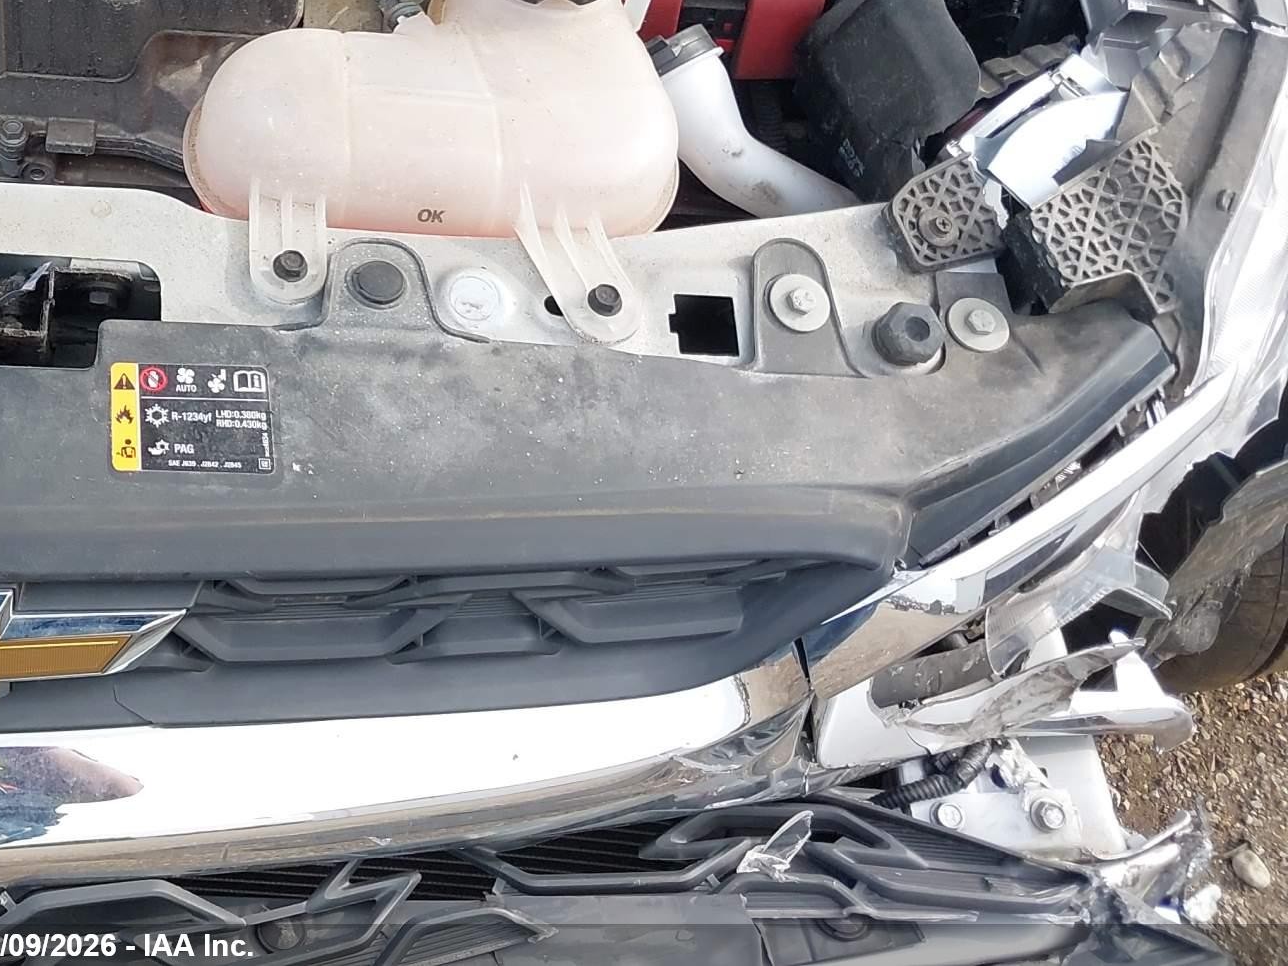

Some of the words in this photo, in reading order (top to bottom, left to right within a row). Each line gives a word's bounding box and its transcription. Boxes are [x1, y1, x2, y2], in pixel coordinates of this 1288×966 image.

[417, 208, 446, 223] OK
[175, 384, 197, 393] AUTO
[171, 411, 213, 424] R-1234yf
[173, 443, 195, 454] PAG
